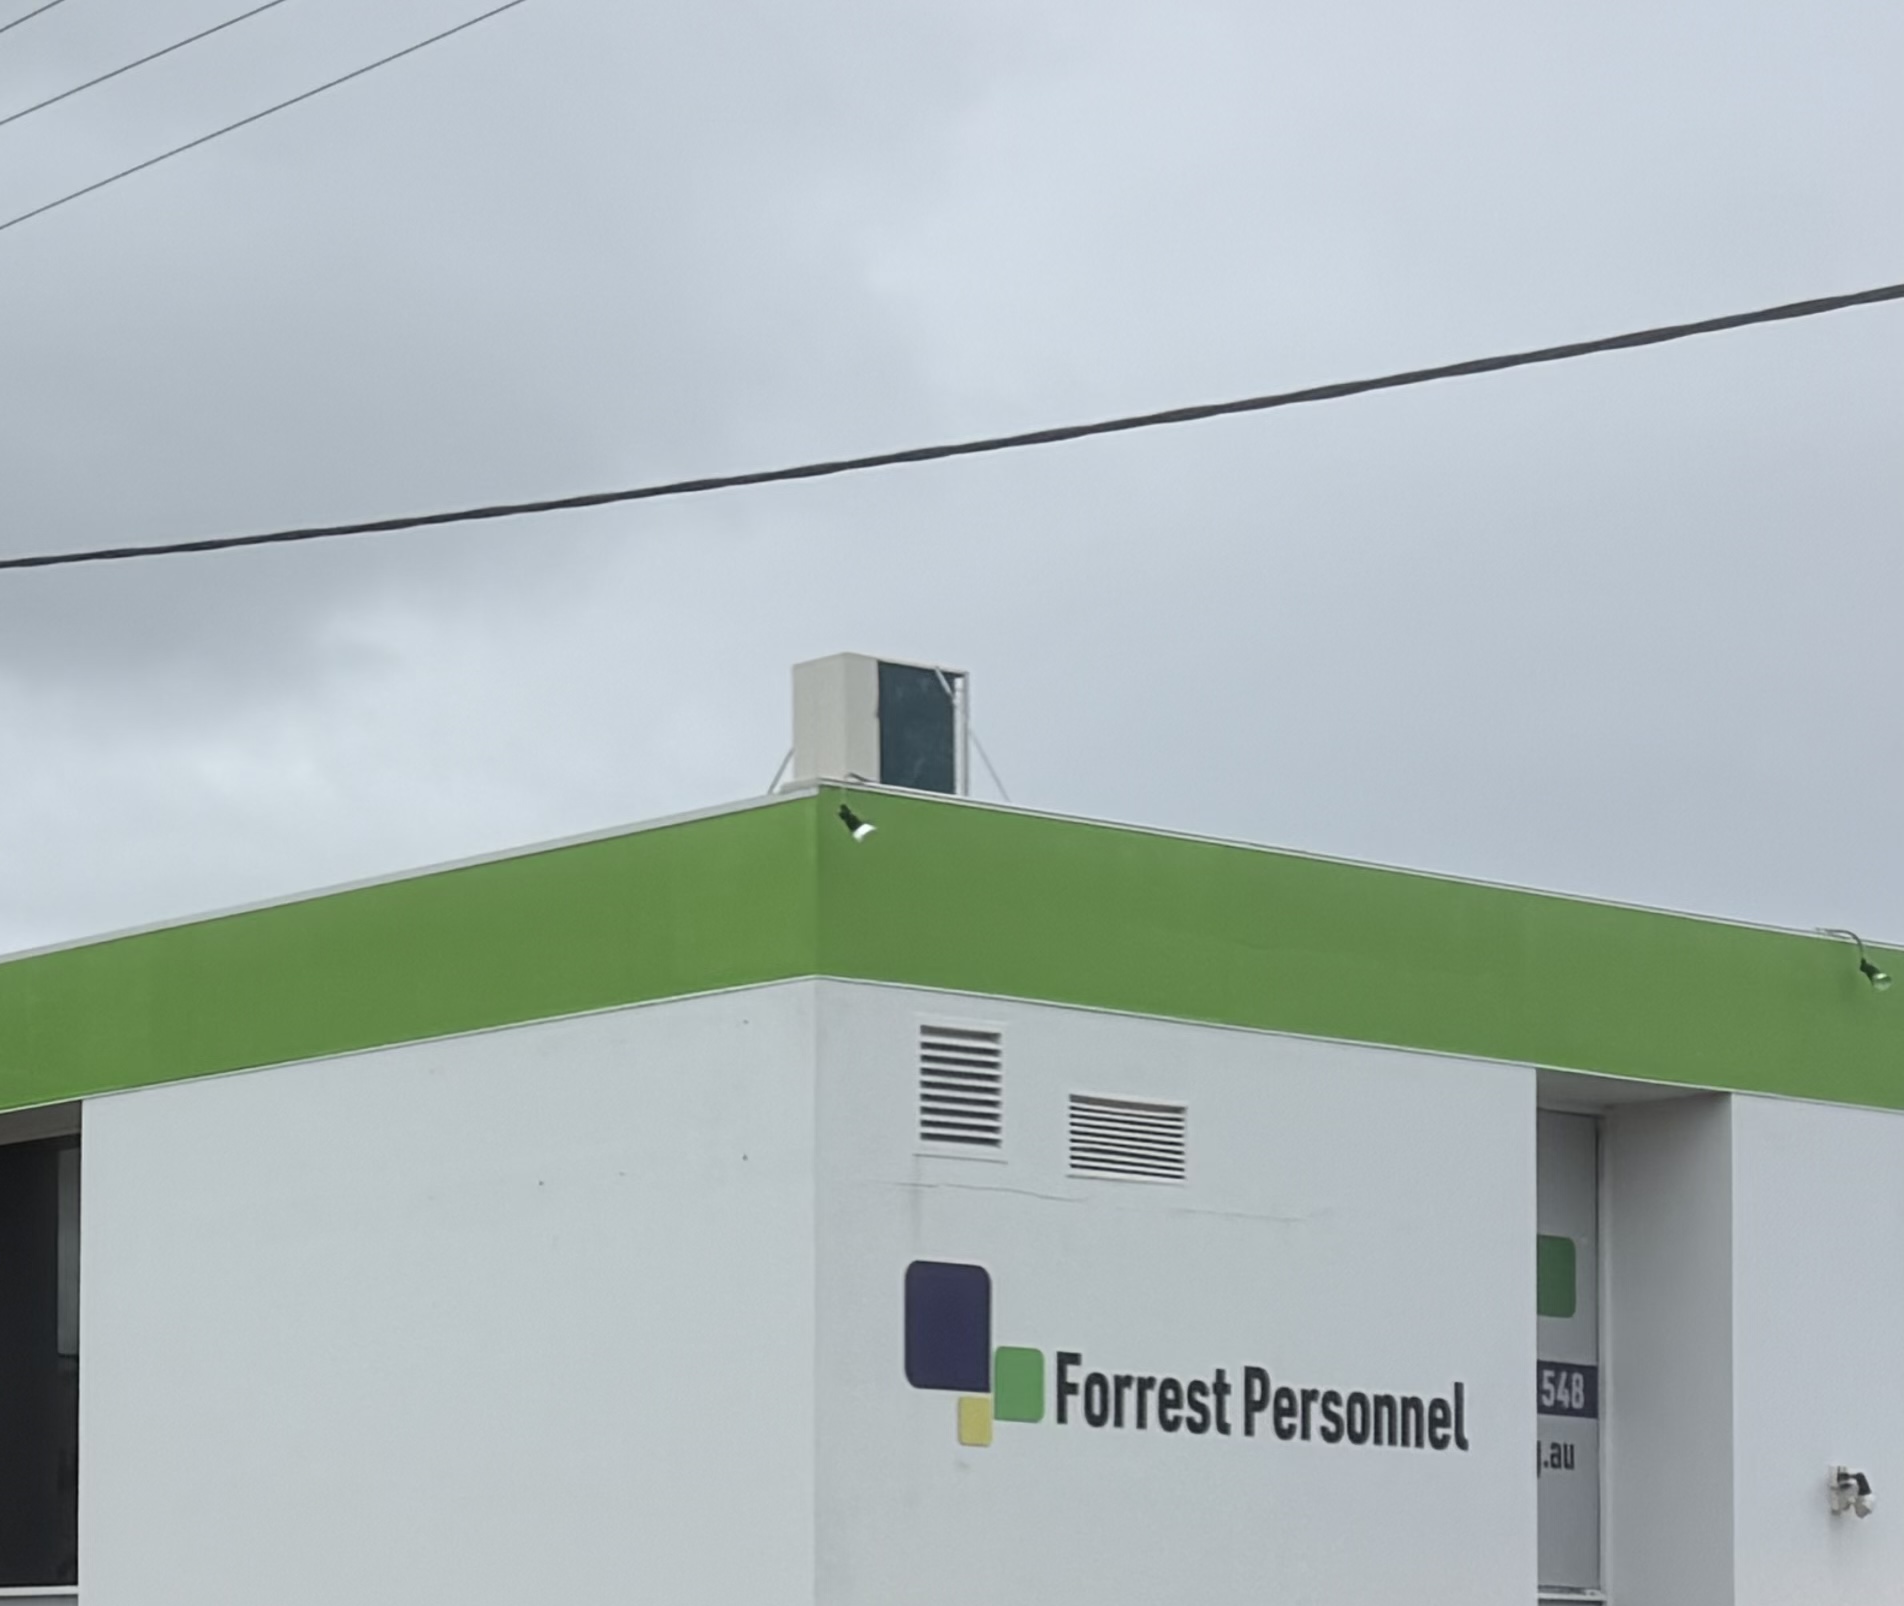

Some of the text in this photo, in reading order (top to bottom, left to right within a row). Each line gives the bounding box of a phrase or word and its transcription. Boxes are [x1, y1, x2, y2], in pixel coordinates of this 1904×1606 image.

[1055, 1351, 1470, 1452] Forrest Personnel
[1541, 1368, 1585, 1409] 548
